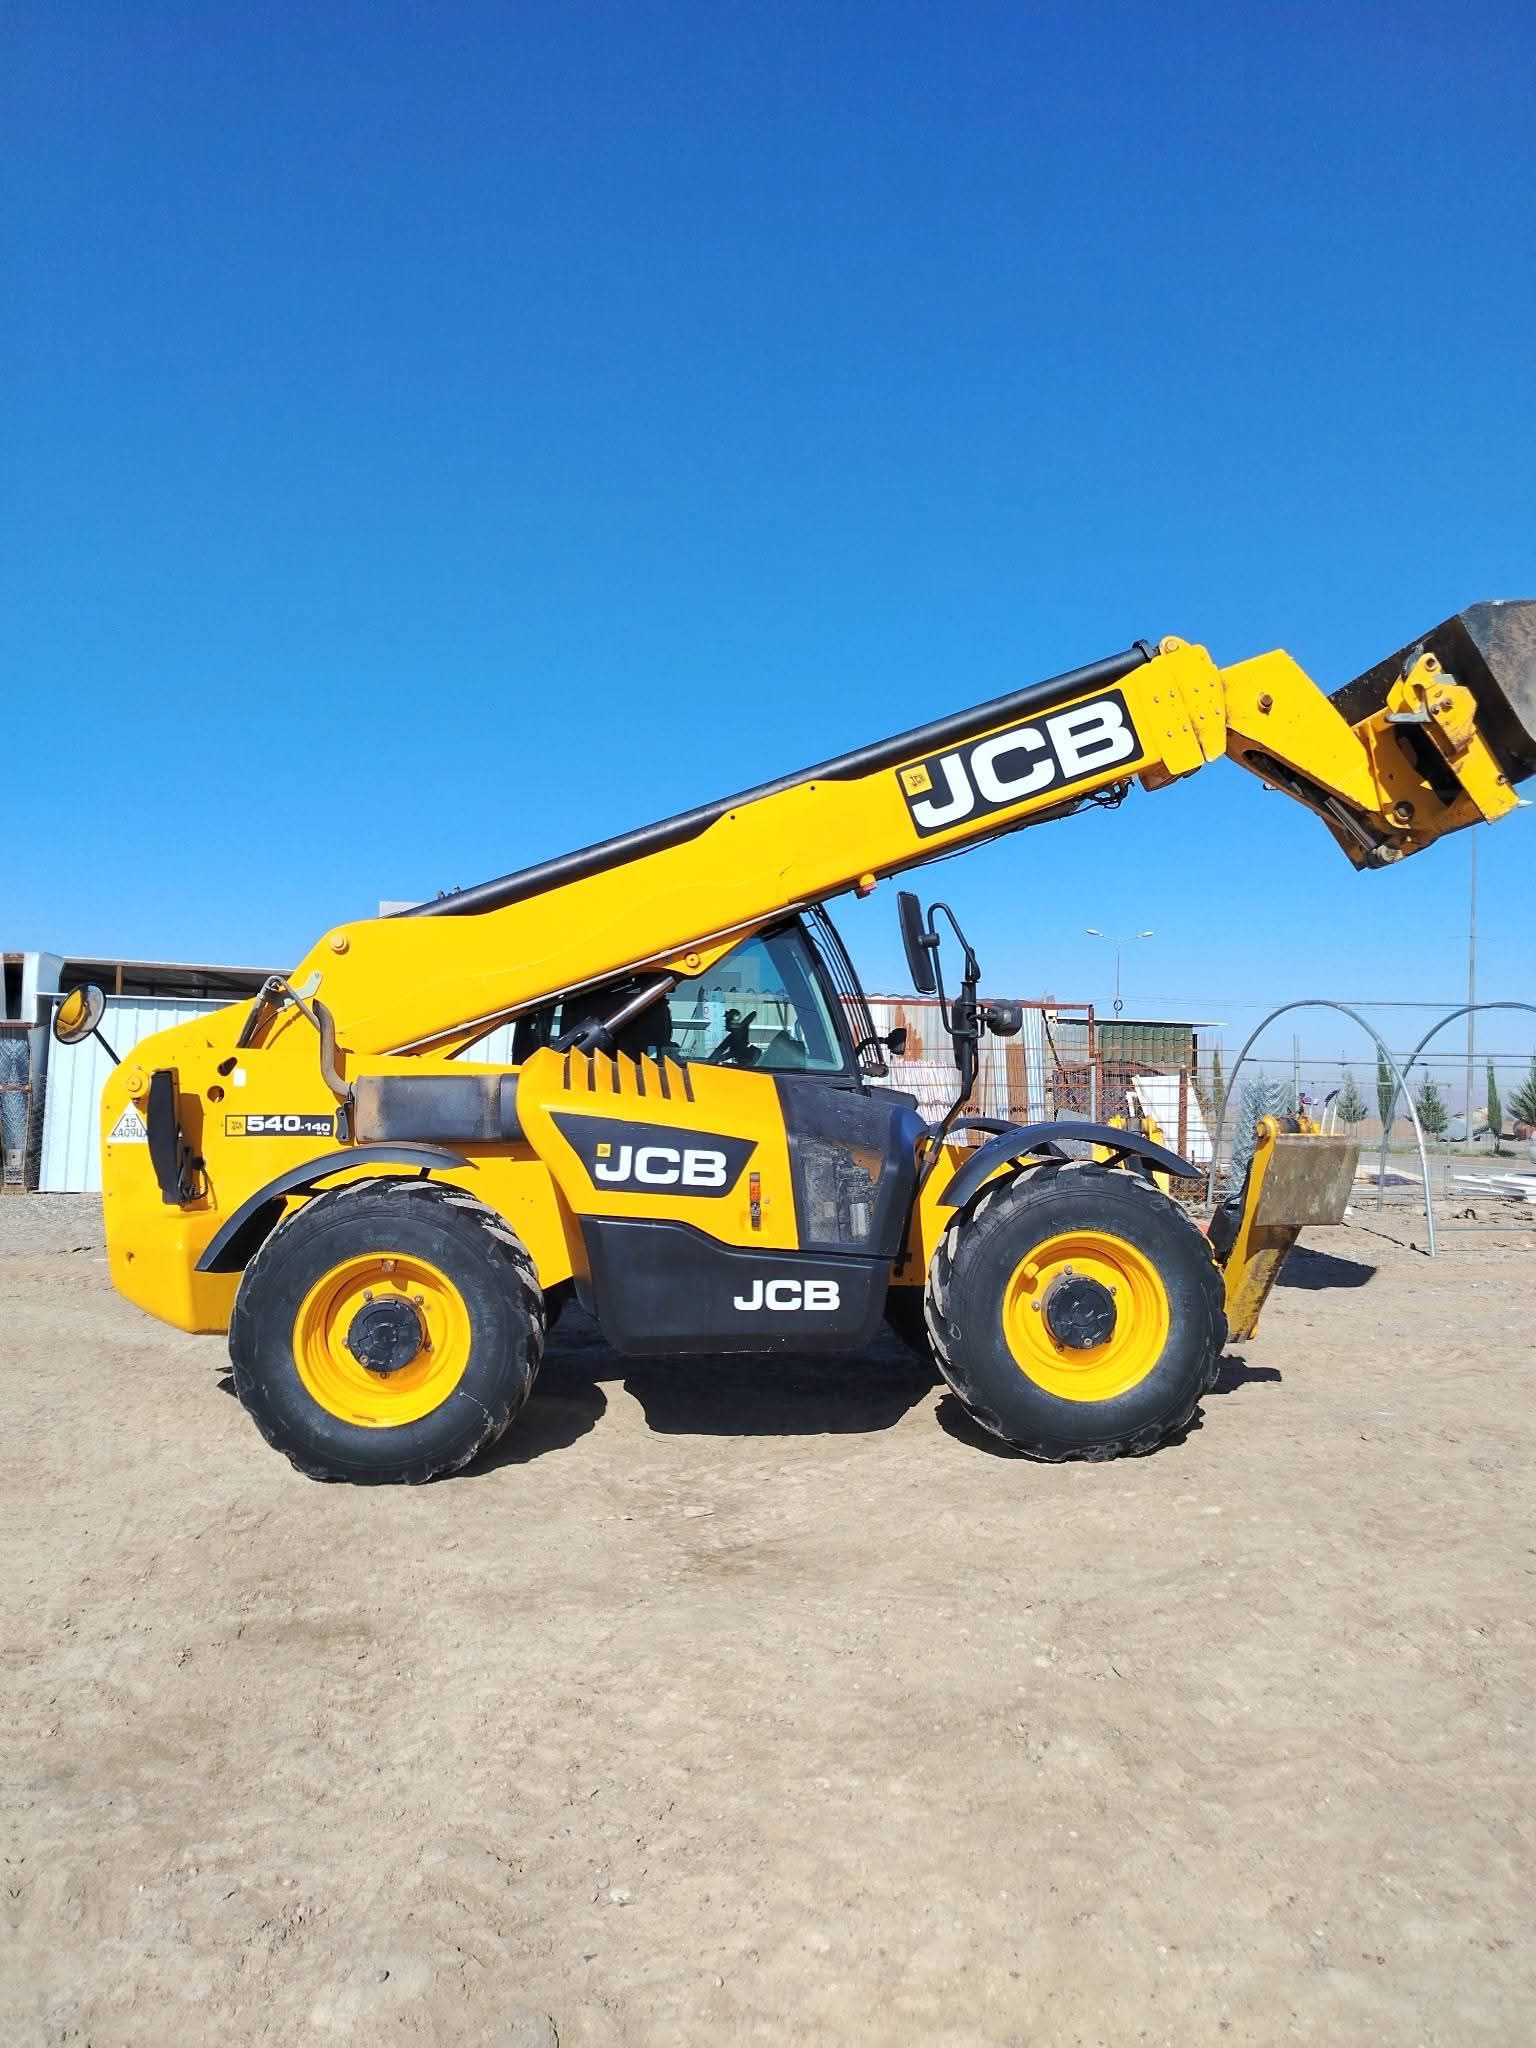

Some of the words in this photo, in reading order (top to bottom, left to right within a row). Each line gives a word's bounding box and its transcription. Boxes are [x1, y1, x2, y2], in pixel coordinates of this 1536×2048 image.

[911, 701, 1135, 828] JCB
[124, 1118, 137, 1128] 15
[595, 1145, 727, 1187] JCB
[733, 1279, 841, 1311] JCB
